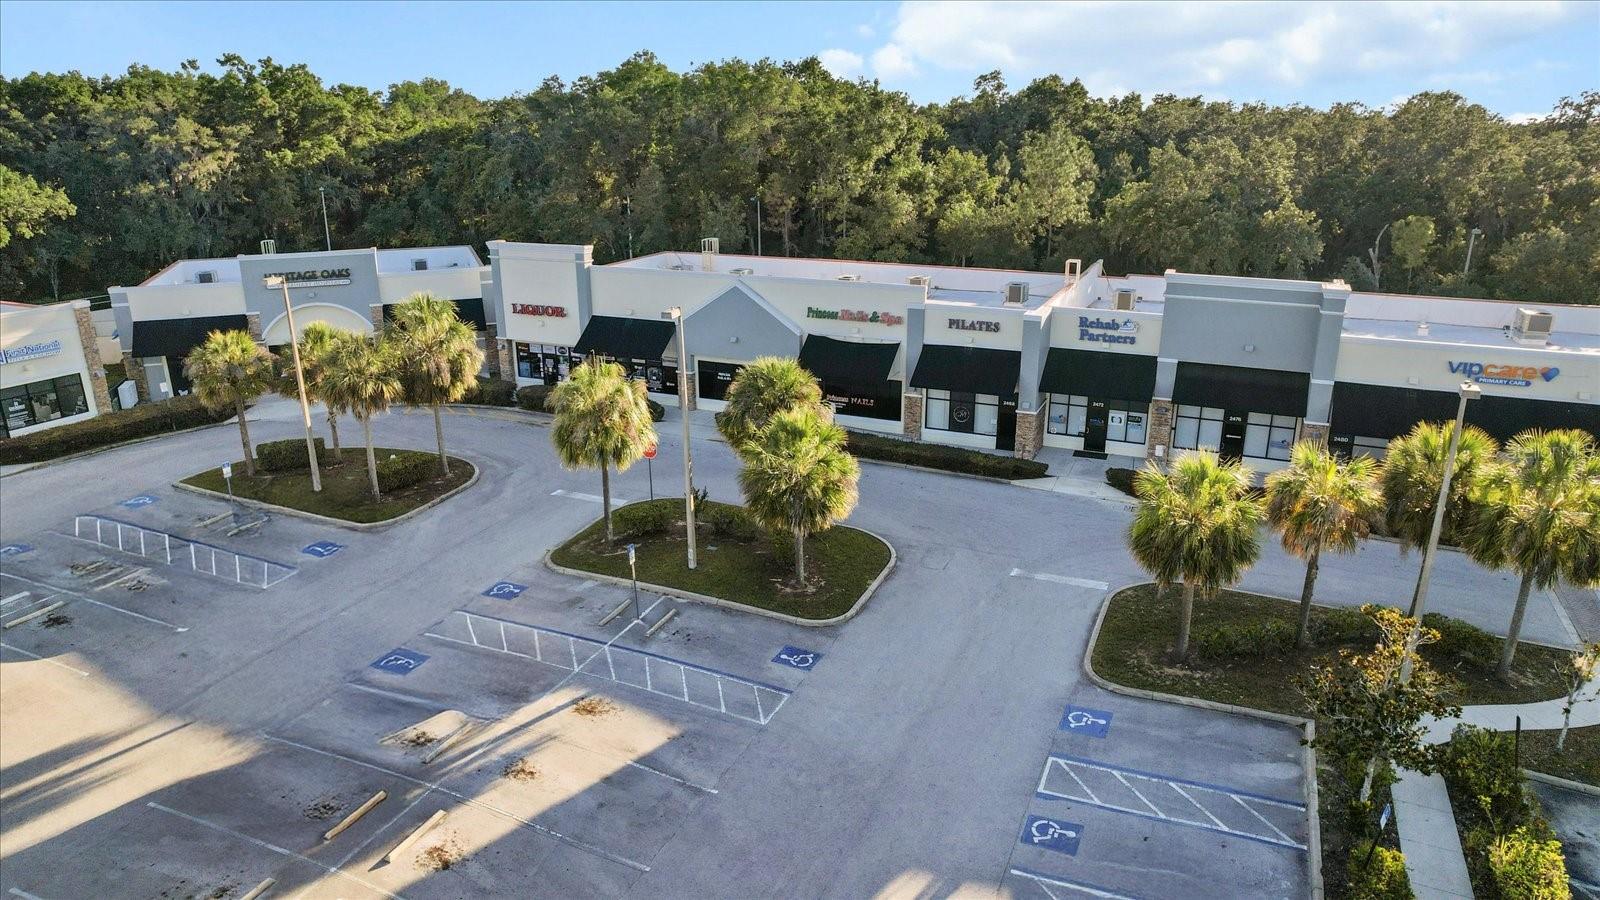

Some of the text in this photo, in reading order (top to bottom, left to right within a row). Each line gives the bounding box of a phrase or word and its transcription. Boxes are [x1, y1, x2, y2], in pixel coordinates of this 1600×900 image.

[321, 268, 351, 279] OAKS
[511, 302, 567, 318] LIQUOR
[869, 311, 879, 323] &
[1078, 316, 1119, 331] Rehab
[947, 318, 1001, 333] PILATES
[1078, 329, 1136, 345] Partners
[1478, 377, 1507, 386] PRIMARY
[850, 397, 875, 407] NAILS
